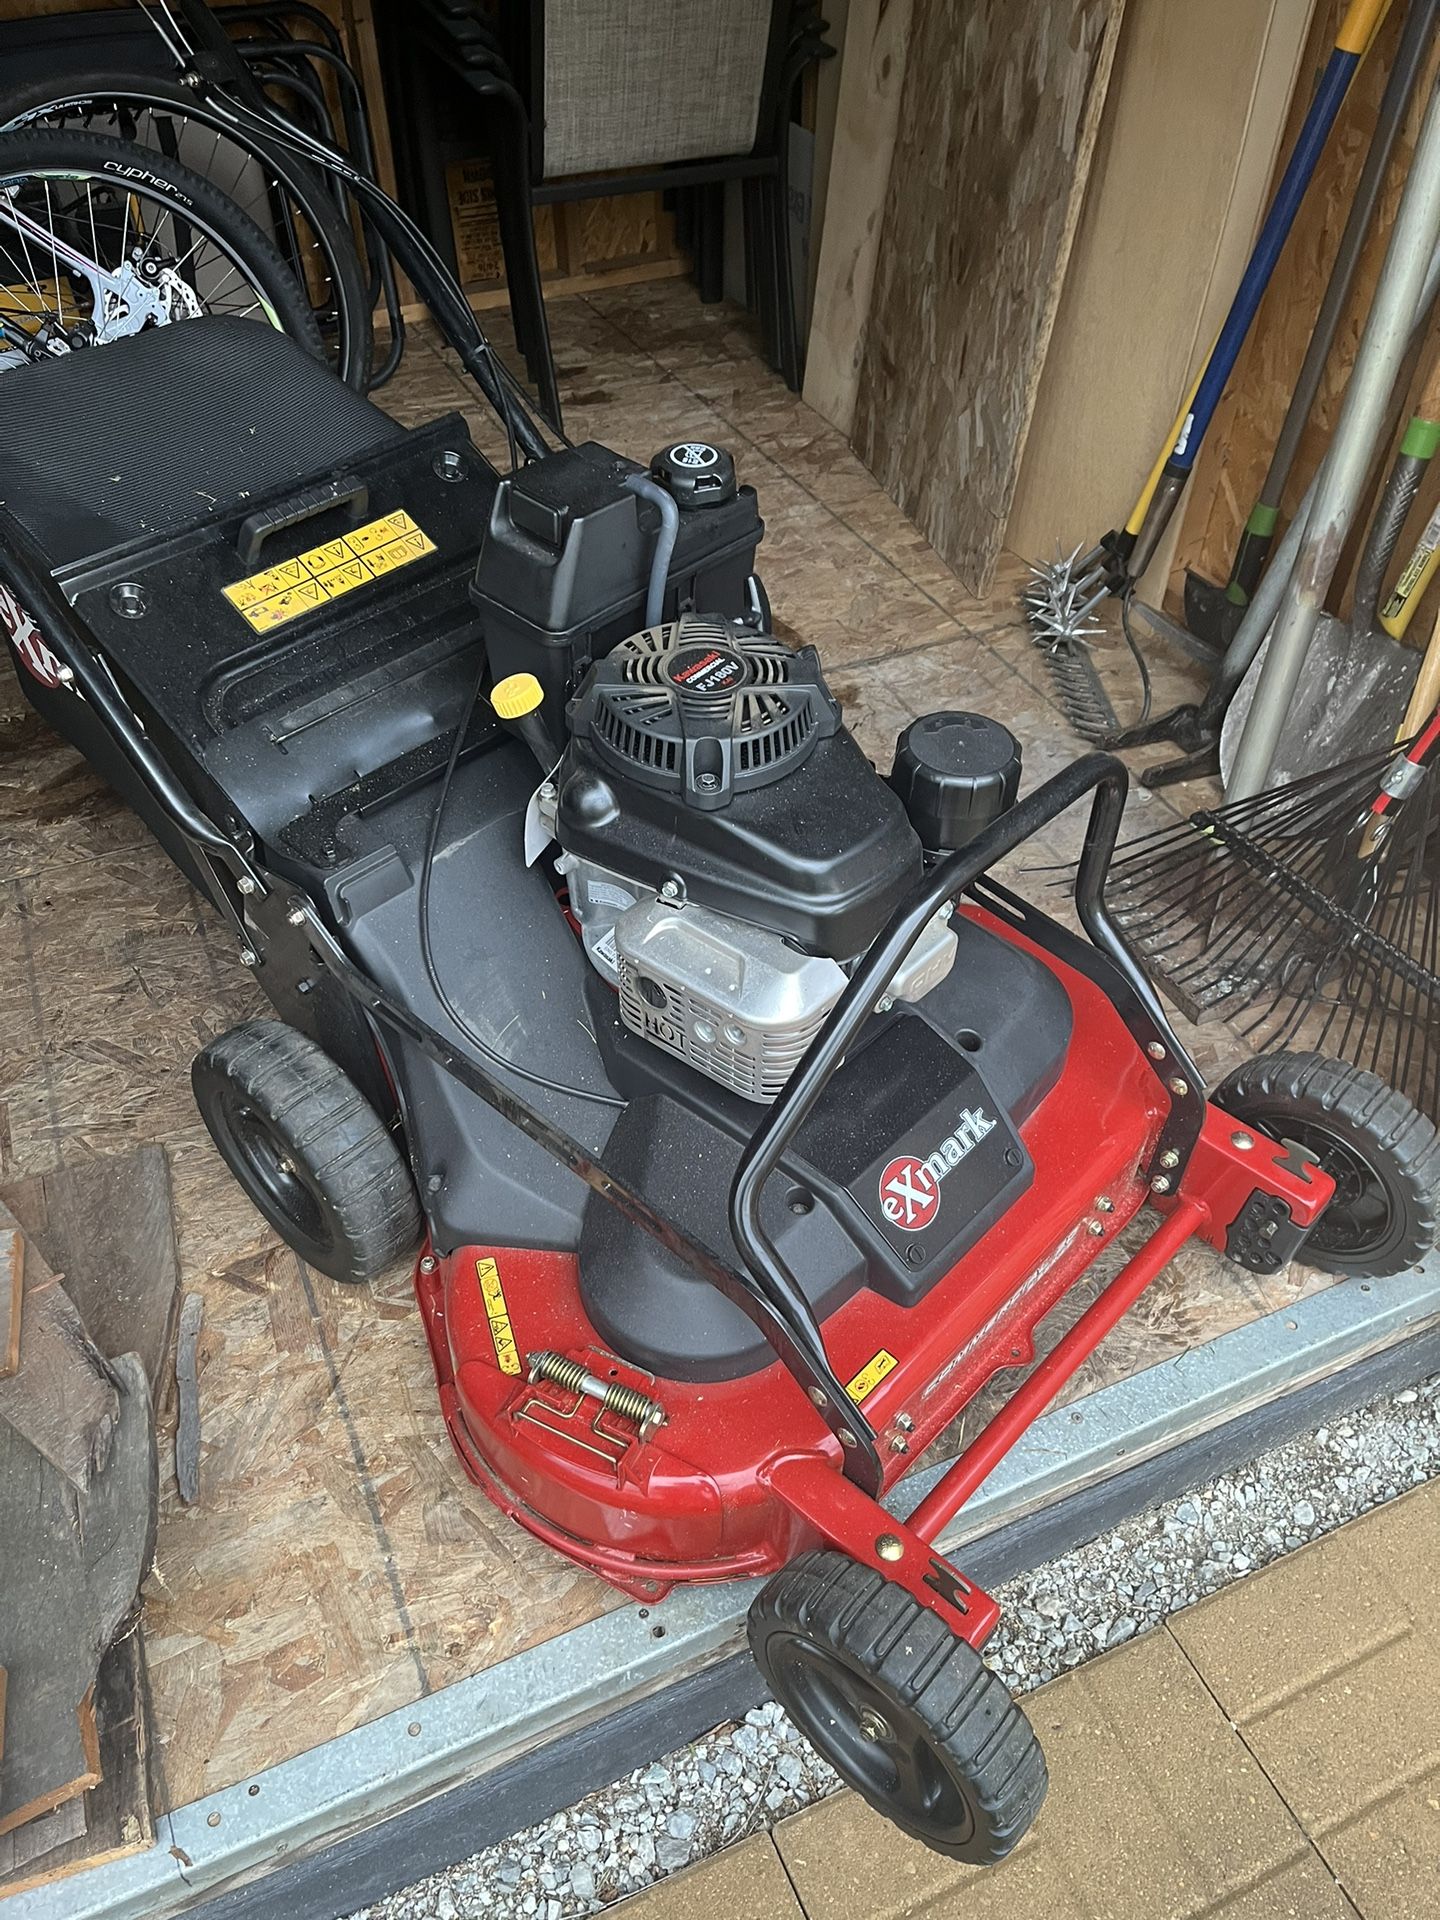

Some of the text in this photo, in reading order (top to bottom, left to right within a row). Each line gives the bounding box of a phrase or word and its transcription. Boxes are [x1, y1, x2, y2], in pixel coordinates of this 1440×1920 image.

[103, 161, 177, 193] cypher
[672, 650, 721, 682] Kawasaki
[685, 657, 726, 684] COMMERCIAL
[695, 661, 739, 692] FJ180V
[645, 1011, 687, 1049] HOT
[881, 1106, 998, 1226] eXmark
